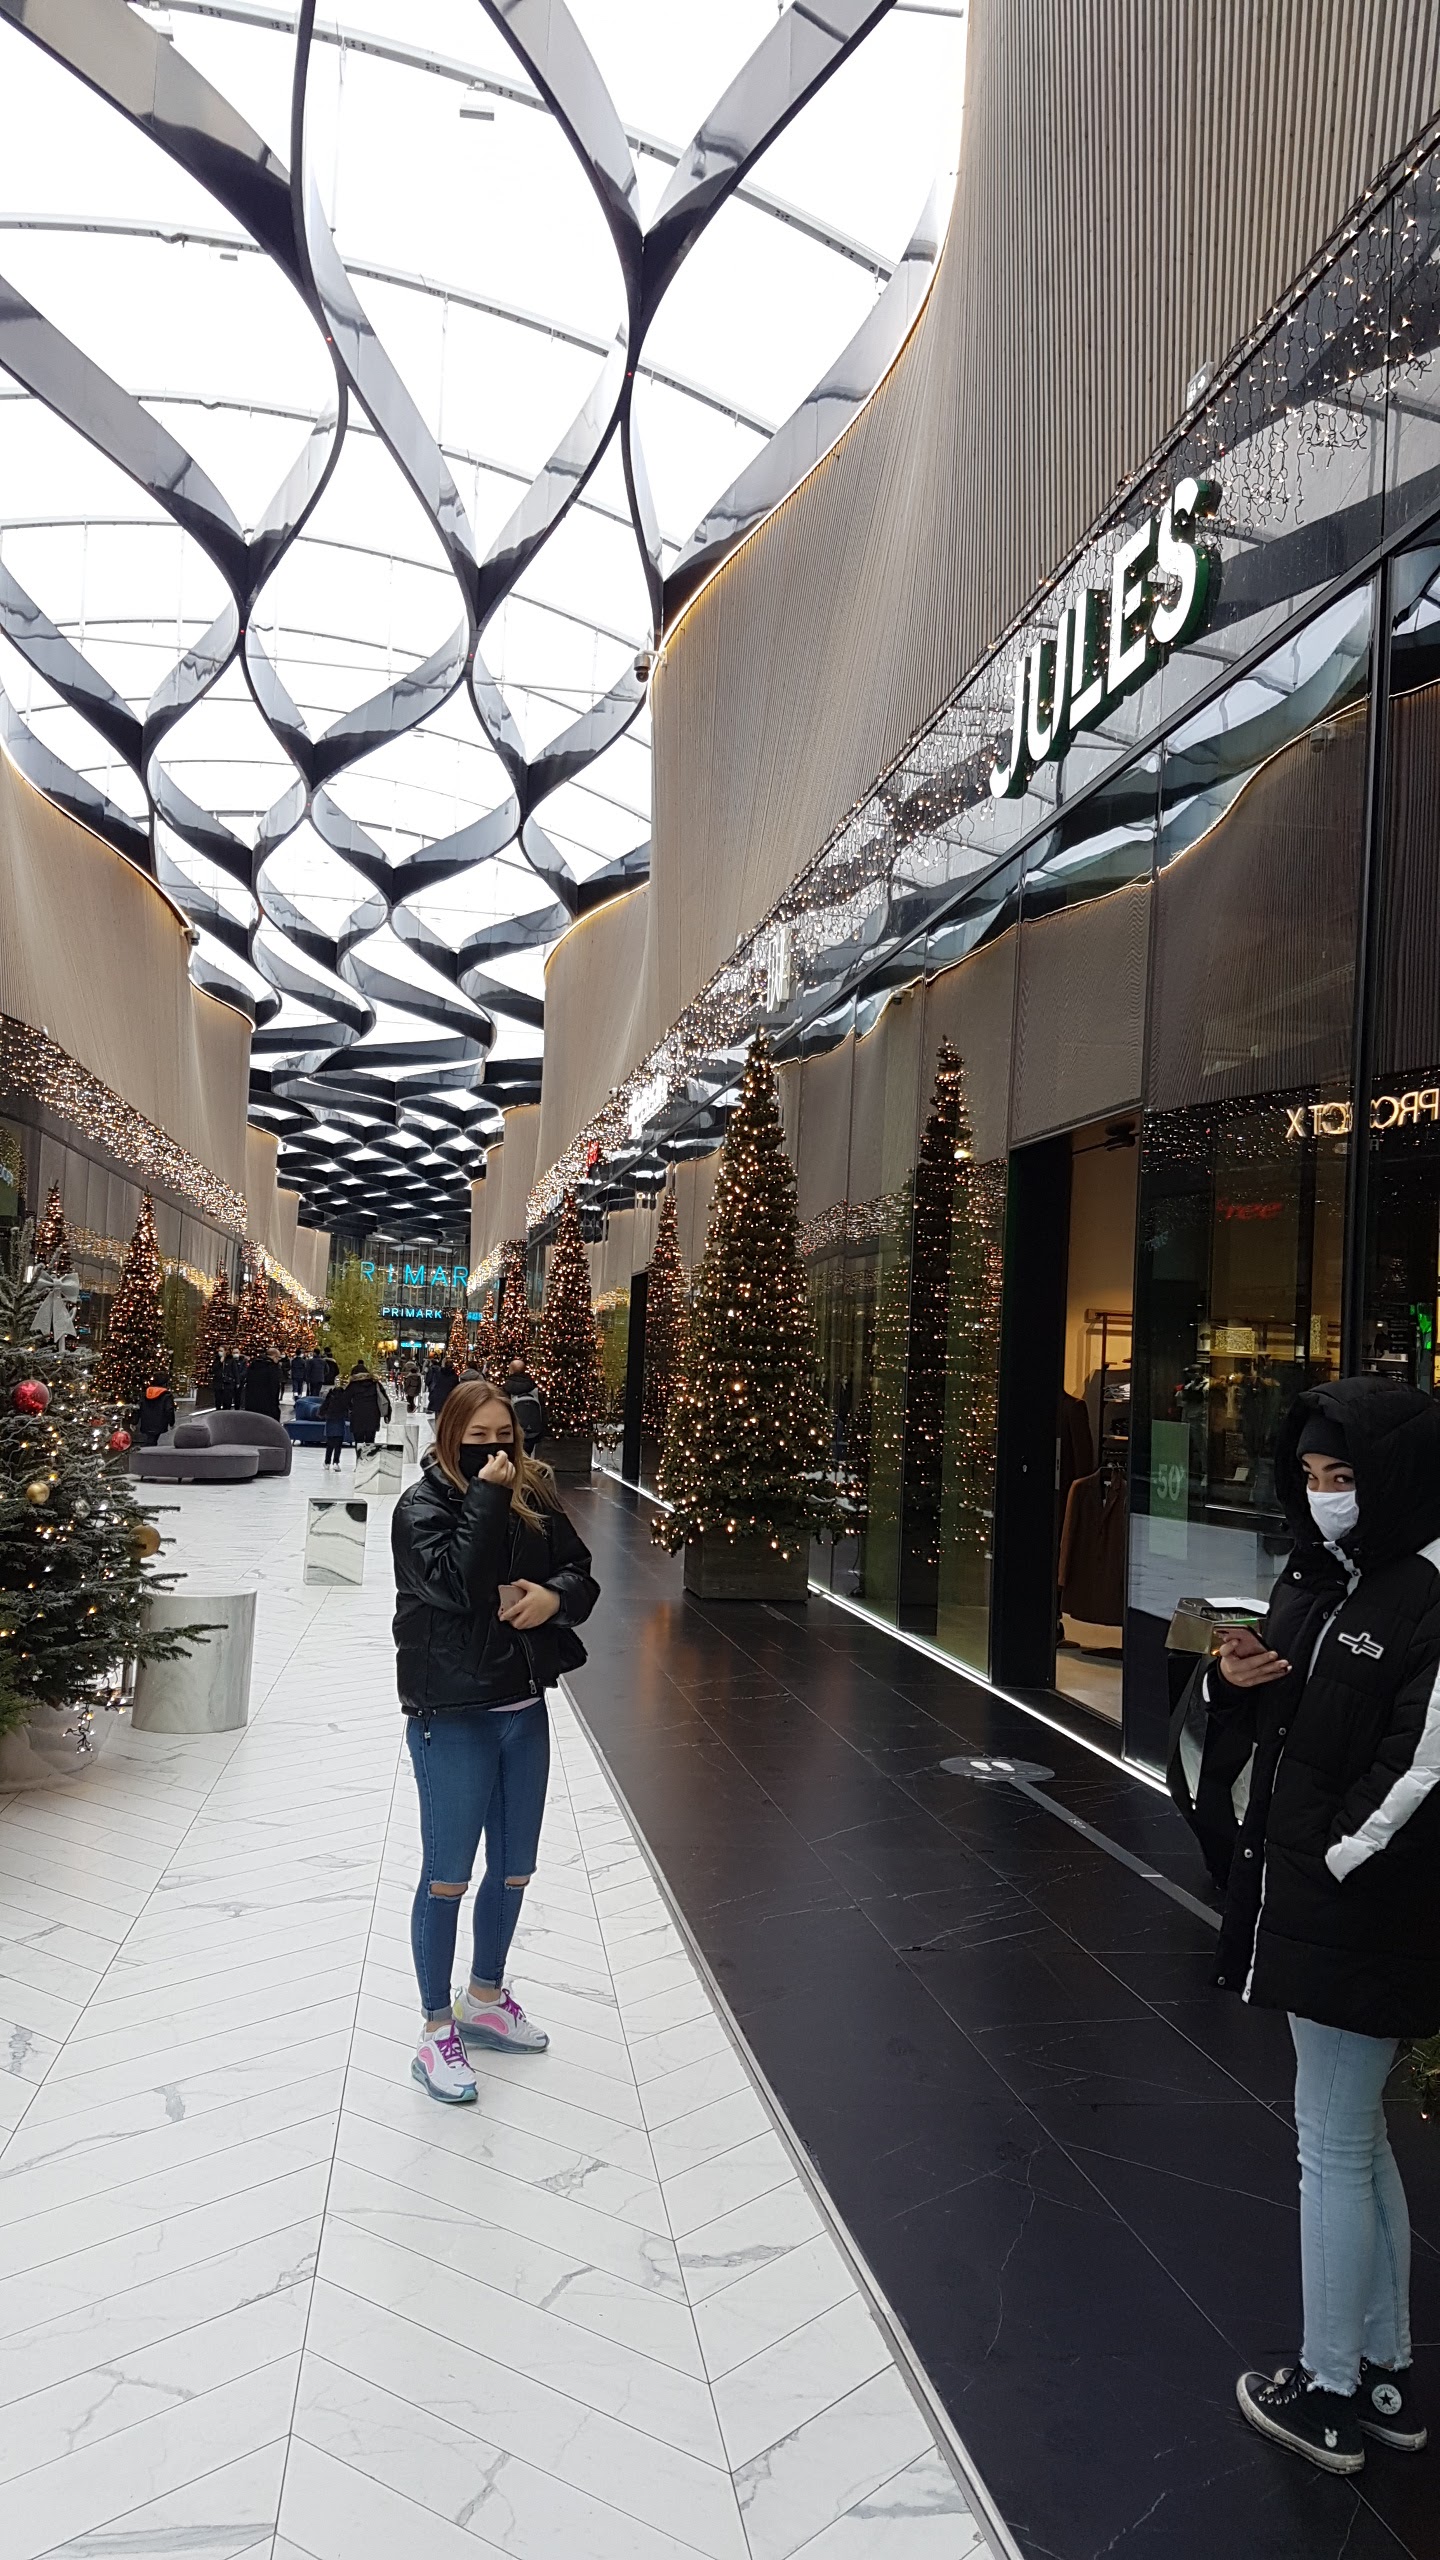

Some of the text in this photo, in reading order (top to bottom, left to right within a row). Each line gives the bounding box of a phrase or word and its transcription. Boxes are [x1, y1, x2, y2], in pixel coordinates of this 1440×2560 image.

[989, 477, 1200, 798] JULES
[342, 1261, 469, 1287] RIMAR
[382, 1307, 442, 1319] PRIMARK
